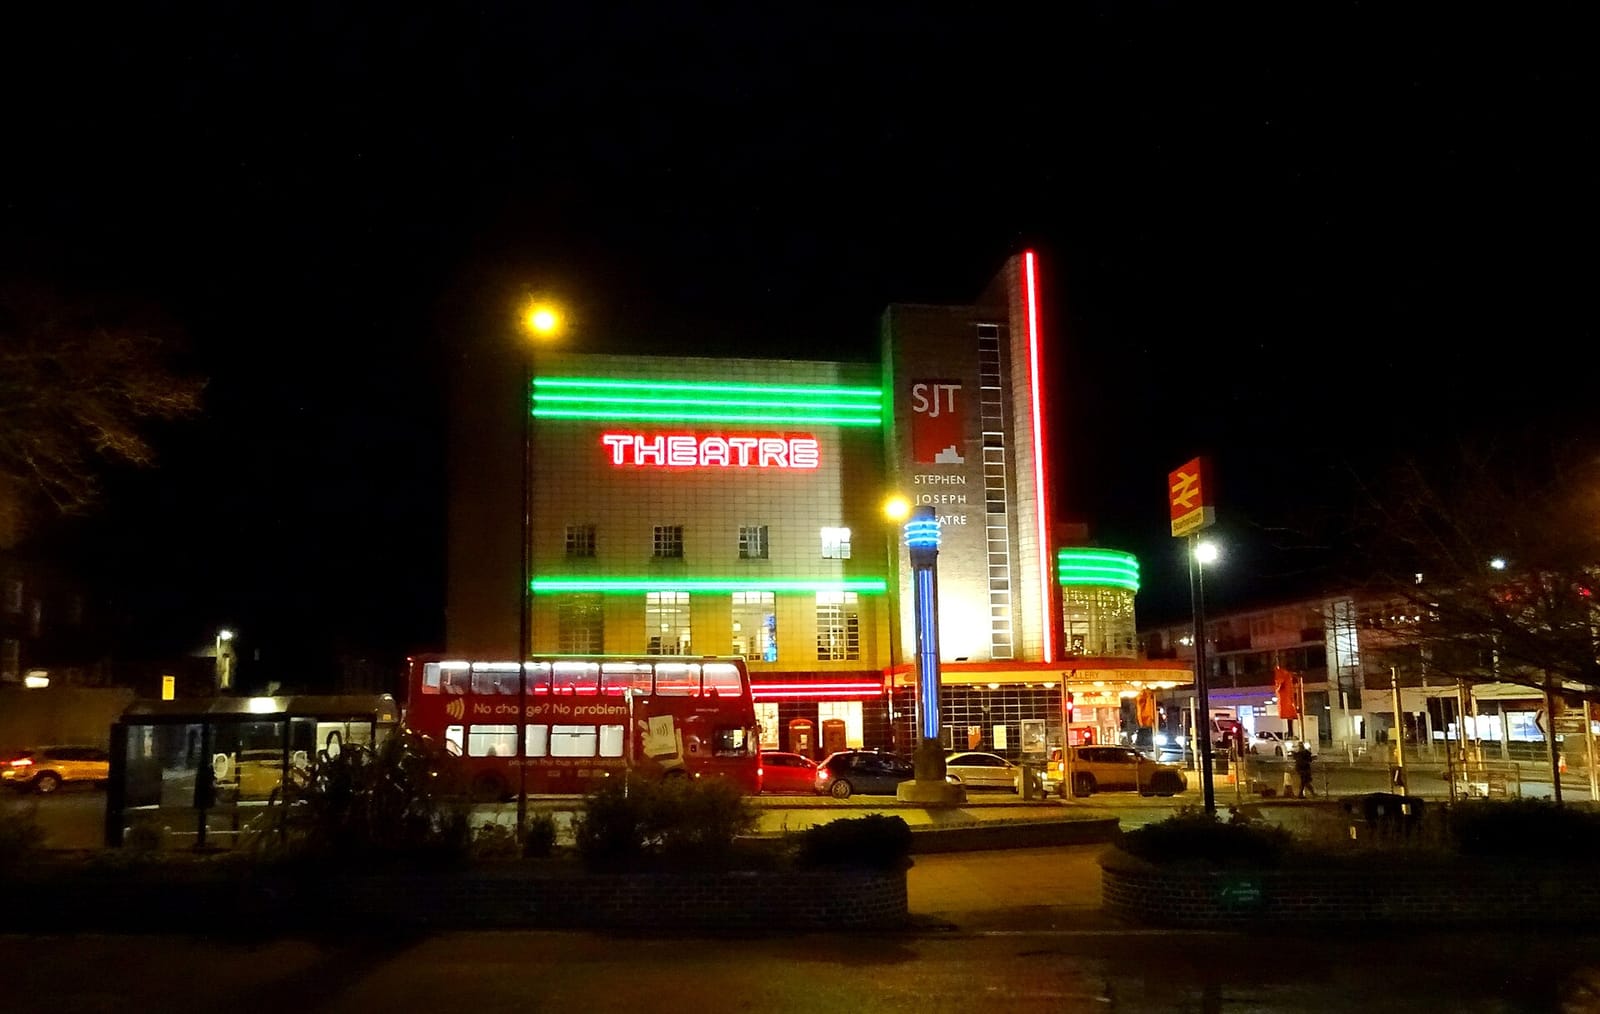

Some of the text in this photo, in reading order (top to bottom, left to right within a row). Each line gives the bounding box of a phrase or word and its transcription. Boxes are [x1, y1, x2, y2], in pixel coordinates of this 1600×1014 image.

[912, 383, 962, 418] SJT
[602, 434, 820, 469] THEATRE
[914, 474, 967, 486] STEPHEN
[915, 494, 967, 506] JOSEPH
[936, 515, 967, 525] ATRE
[473, 703, 627, 717] No chage? No problem
